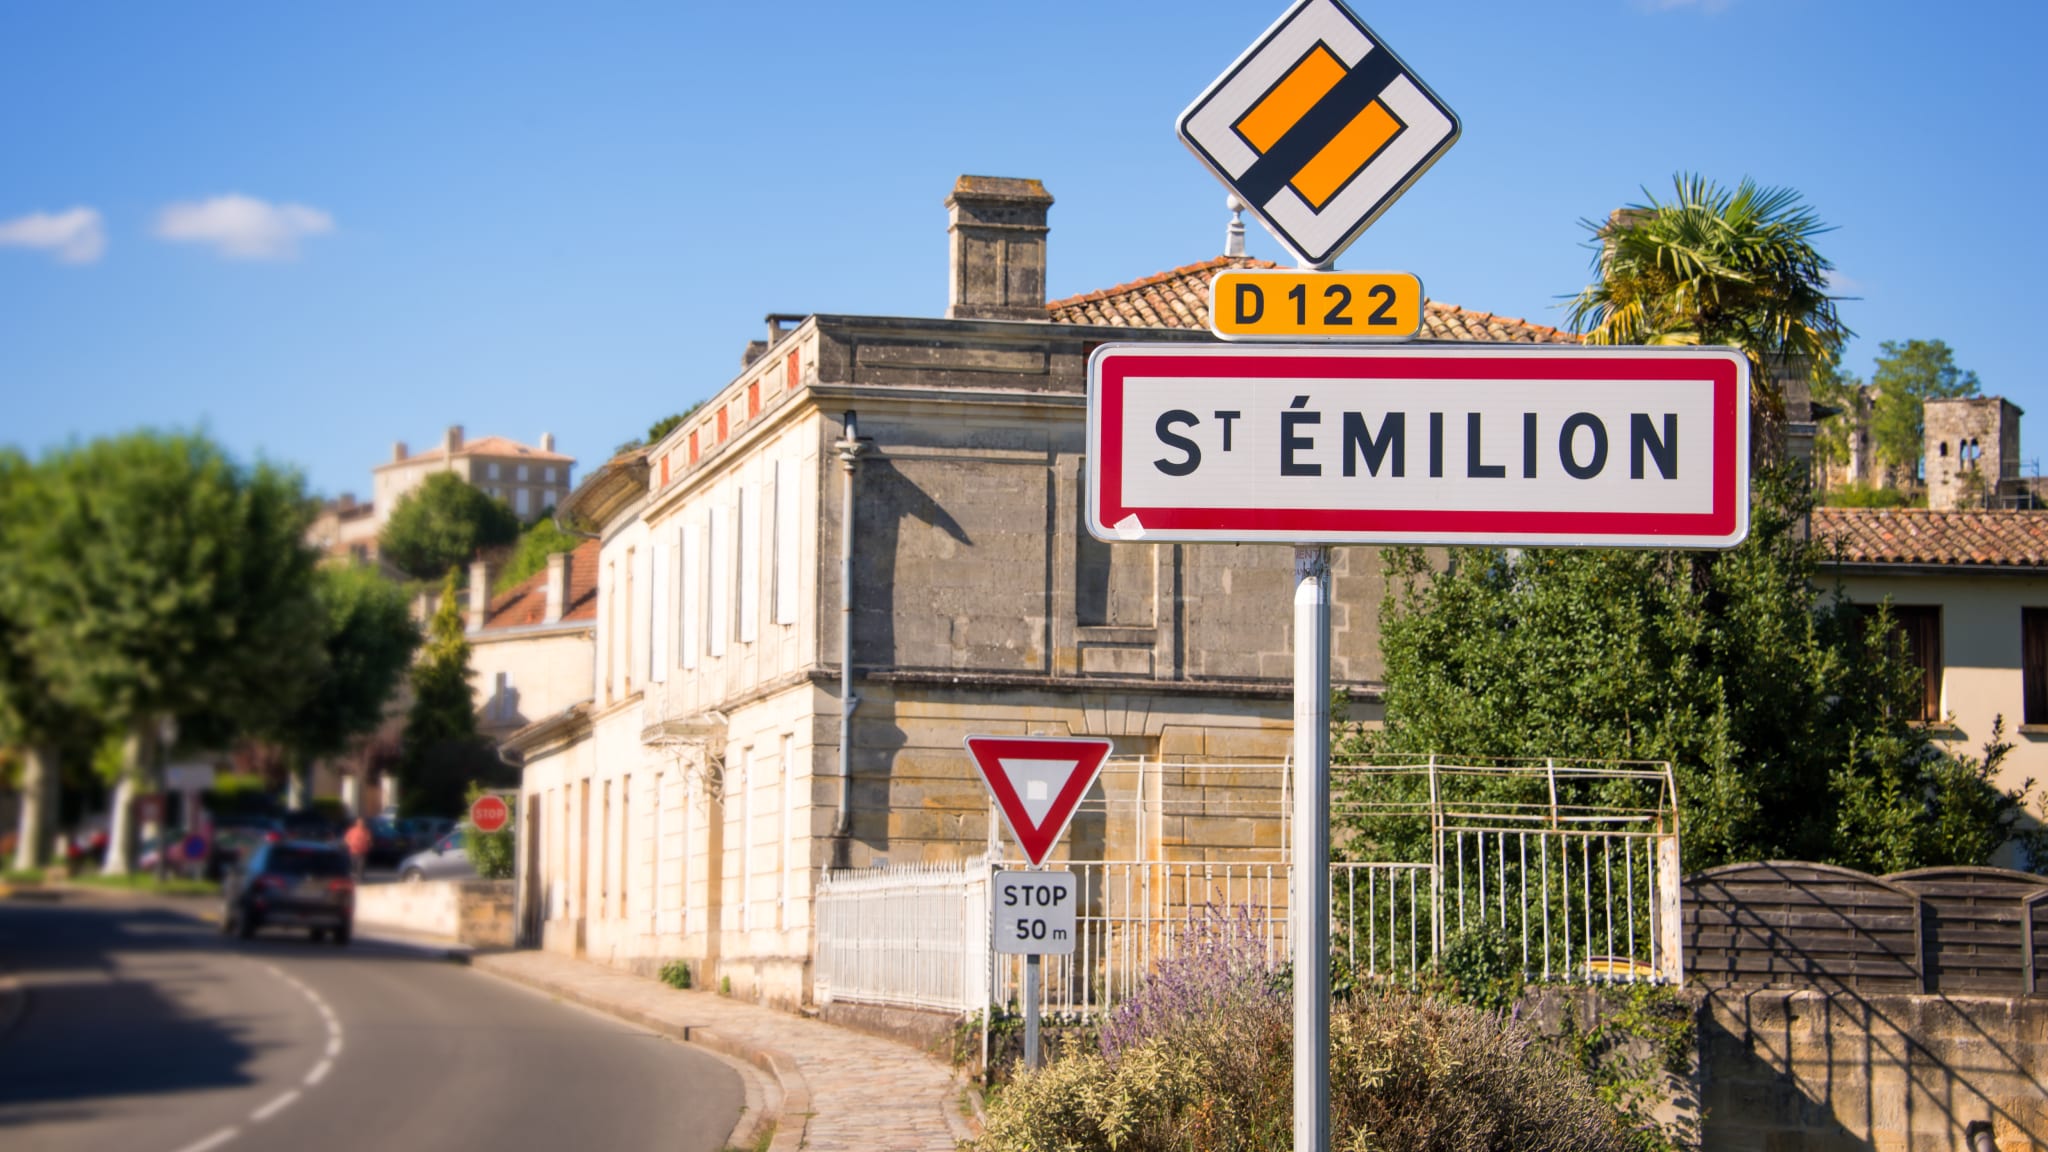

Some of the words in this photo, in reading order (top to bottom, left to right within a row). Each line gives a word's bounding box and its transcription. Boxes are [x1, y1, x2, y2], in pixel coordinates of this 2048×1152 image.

[1235, 283, 1265, 325] D
[1288, 283, 1398, 326] 122
[1280, 395, 1678, 480] ÉMILION
[475, 807, 505, 819] STOP
[1003, 884, 1068, 907] STOP
[1016, 918, 1047, 941] 50
[1052, 927, 1068, 940] m
